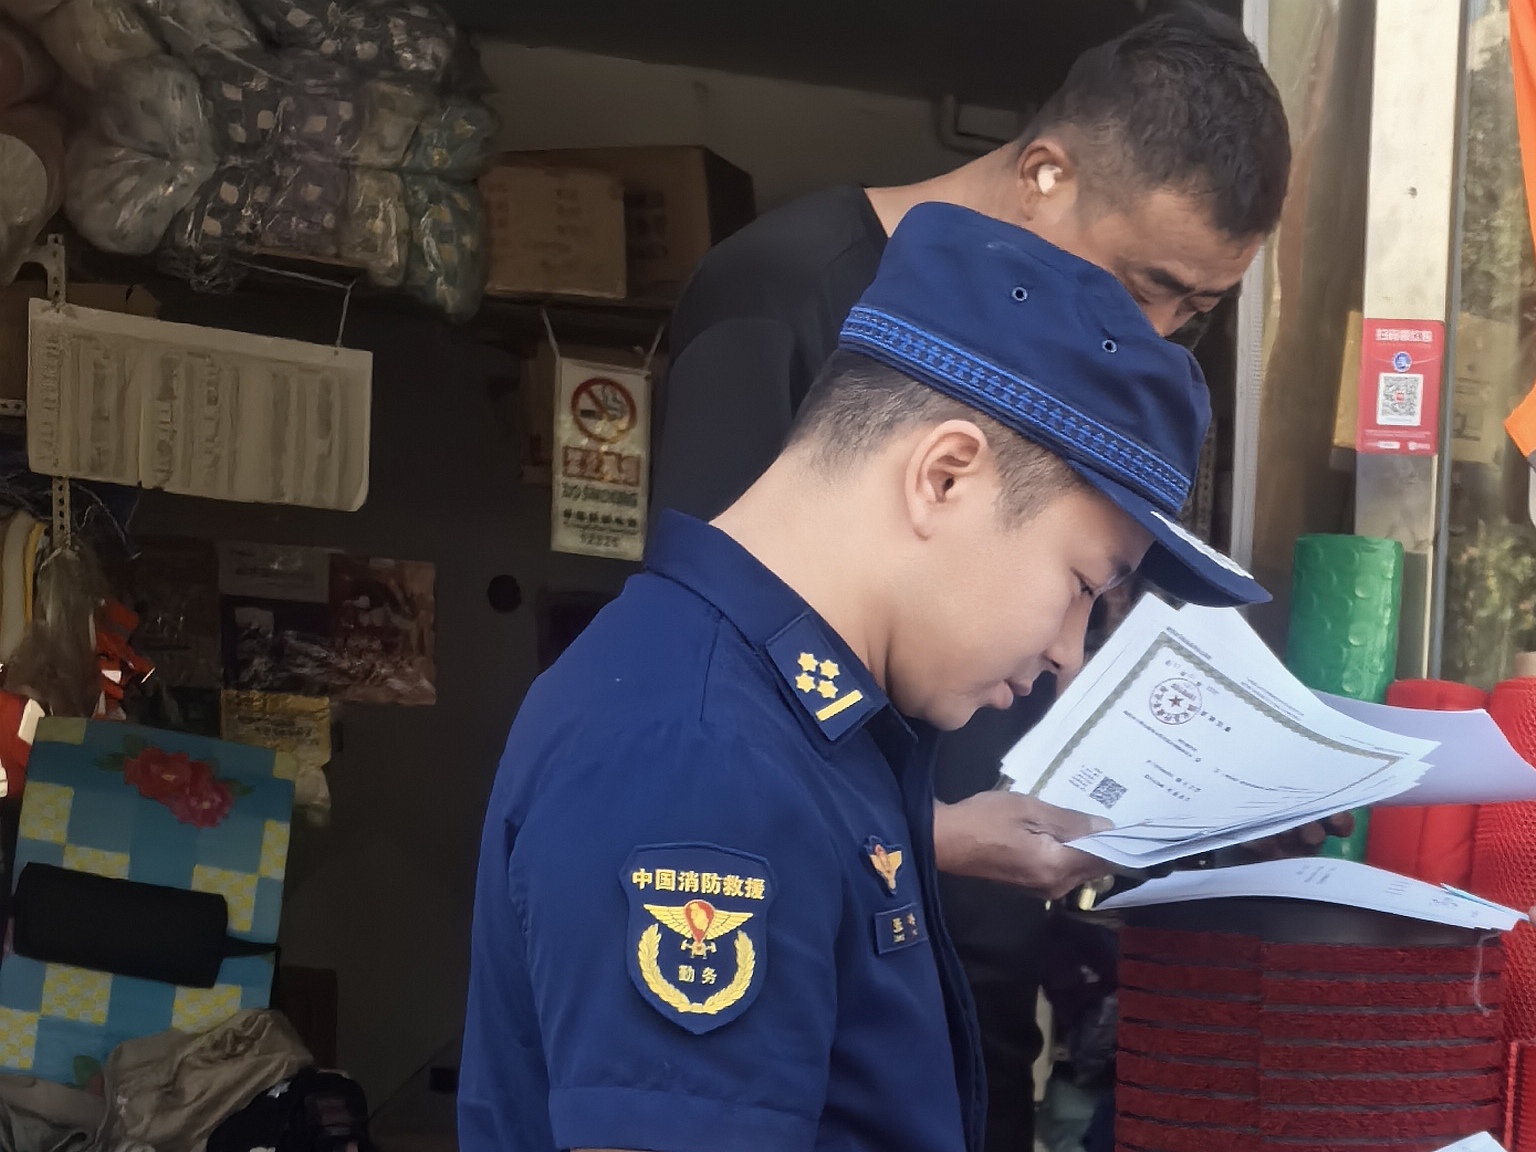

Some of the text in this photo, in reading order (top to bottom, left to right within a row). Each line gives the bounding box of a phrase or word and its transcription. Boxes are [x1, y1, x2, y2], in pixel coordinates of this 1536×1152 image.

[631, 867, 767, 901] 中国消防救援
[677, 964, 718, 985] 勤务
